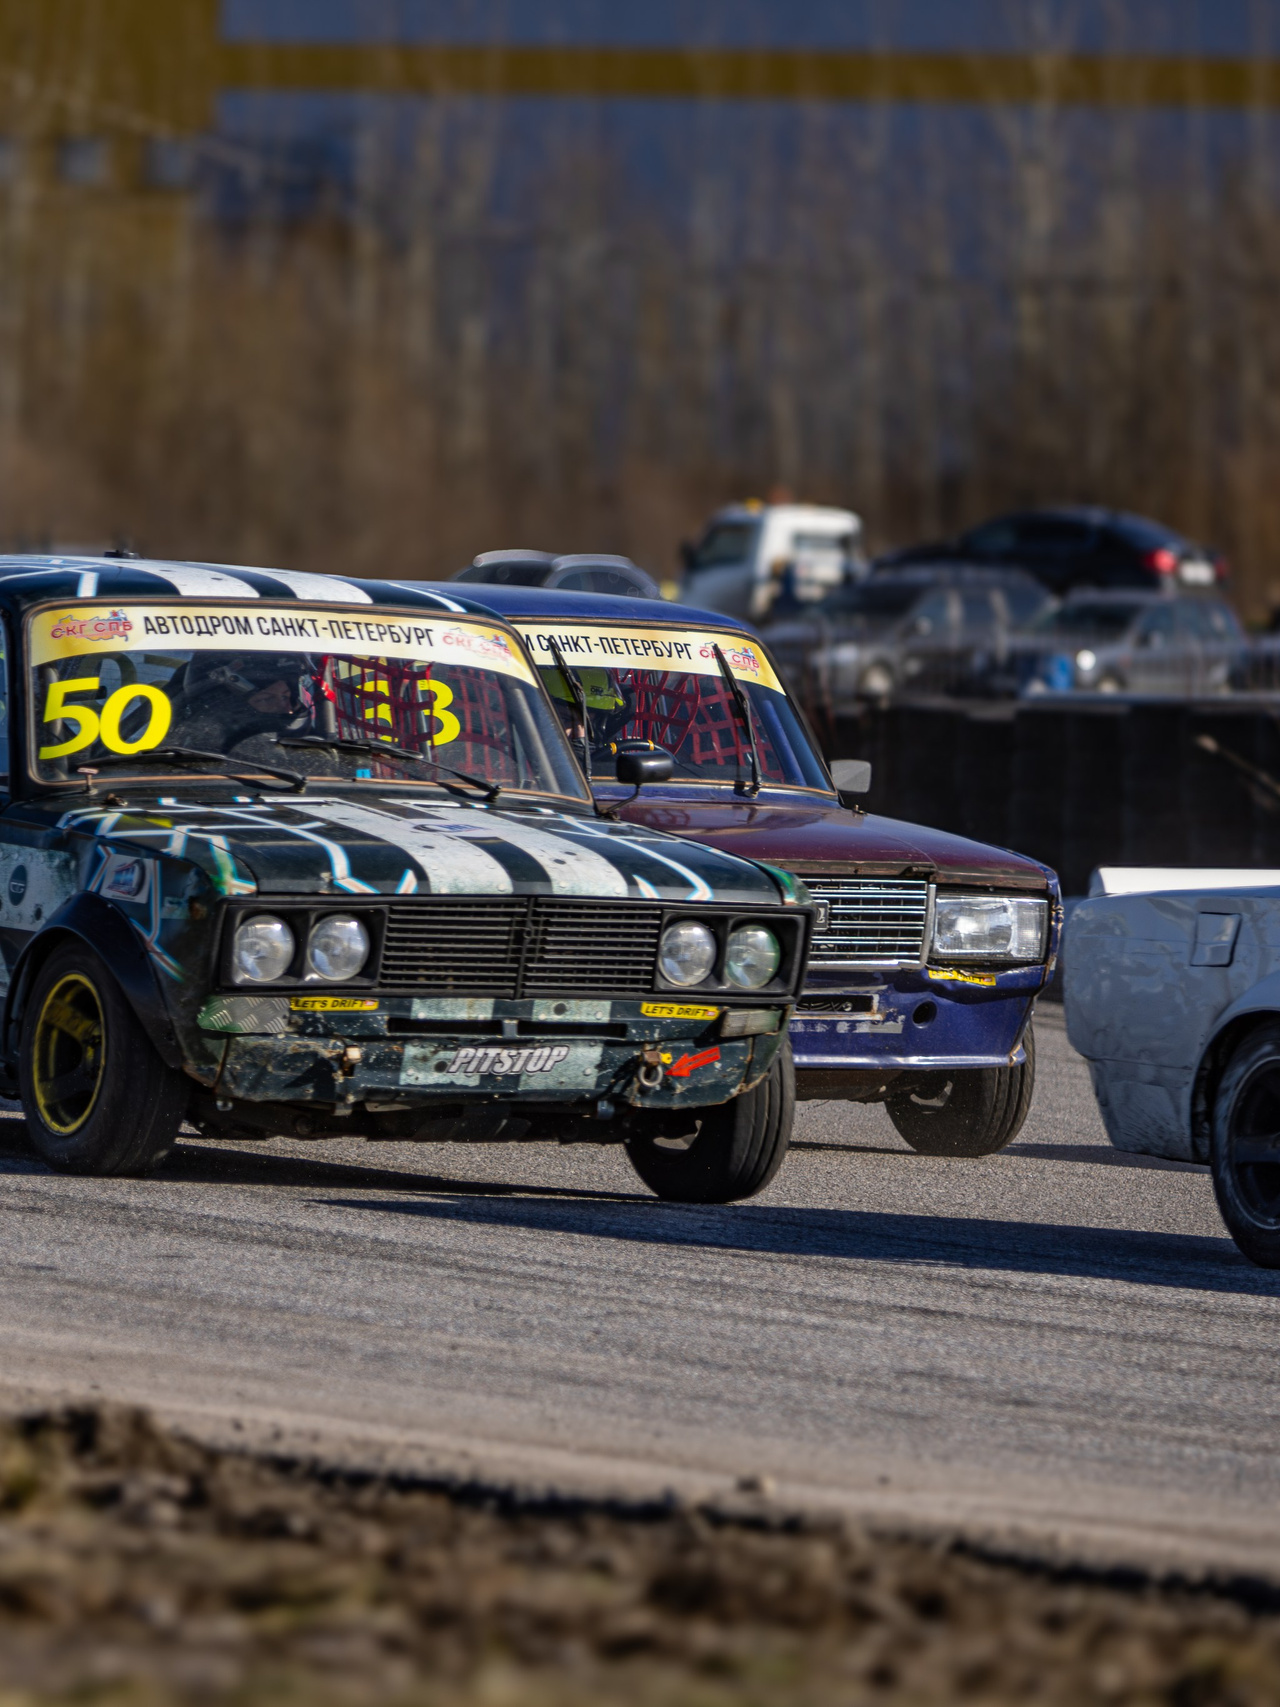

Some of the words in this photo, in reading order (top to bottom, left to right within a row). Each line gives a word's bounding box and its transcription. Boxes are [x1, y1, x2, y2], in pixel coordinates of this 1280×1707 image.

[51, 623, 88, 639] СКГ
[93, 620, 134, 633] СПБ
[143, 615, 254, 637] АВТОДРОМ
[257, 616, 435, 647] САНКТ-ПЕТЕРБУРГ
[536, 633, 693, 660] САНКТ-ПЕТЕРБУРГ
[731, 653, 761, 669] СПБ
[39, 676, 172, 760] 50
[294, 997, 328, 1008] LET'S
[331, 999, 365, 1008] DRIFT
[645, 1005, 675, 1015] LET'S
[676, 1007, 709, 1017] DRIFT
[446, 1045, 571, 1075] PITSTOP
